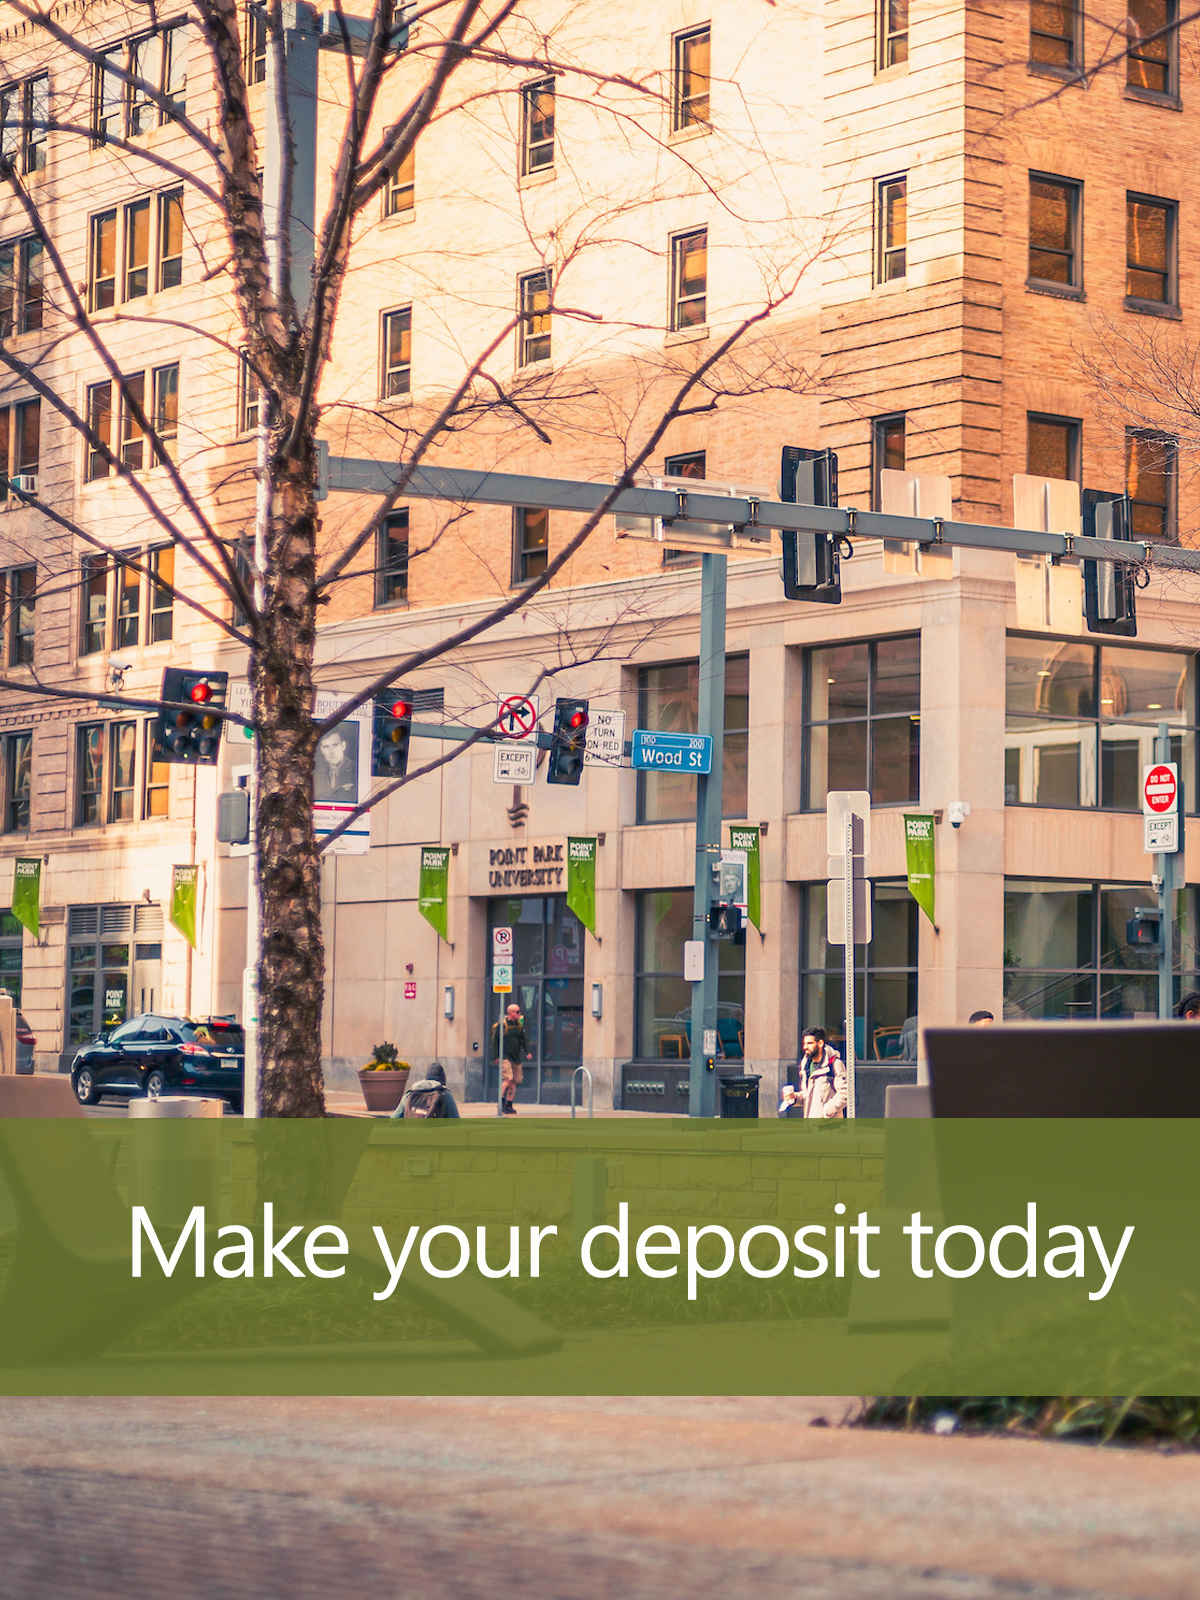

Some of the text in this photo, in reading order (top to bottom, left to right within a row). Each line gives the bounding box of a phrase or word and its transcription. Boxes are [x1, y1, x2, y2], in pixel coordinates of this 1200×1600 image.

[598, 716, 611, 724] NO
[594, 728, 615, 738] TURN
[588, 740, 619, 751] ON RED
[689, 739, 703, 748] 200
[501, 753, 530, 763] EXCEPT
[642, 748, 703, 767] Wood St
[1160, 774, 1171, 783] NOT
[1152, 795, 1169, 805] ENTER
[907, 821, 931, 829] POINT
[1150, 822, 1172, 831] EXCEPT
[732, 832, 757, 841] POINT
[907, 829, 929, 837] PARK
[570, 842, 594, 851] POINT
[733, 840, 754, 848] PARK
[423, 852, 447, 860] POINT
[489, 845, 564, 866] POINT PARK
[488, 868, 564, 888] UNIVERSITY
[106, 990, 123, 999] POINT
[106, 999, 121, 1007] PARK
